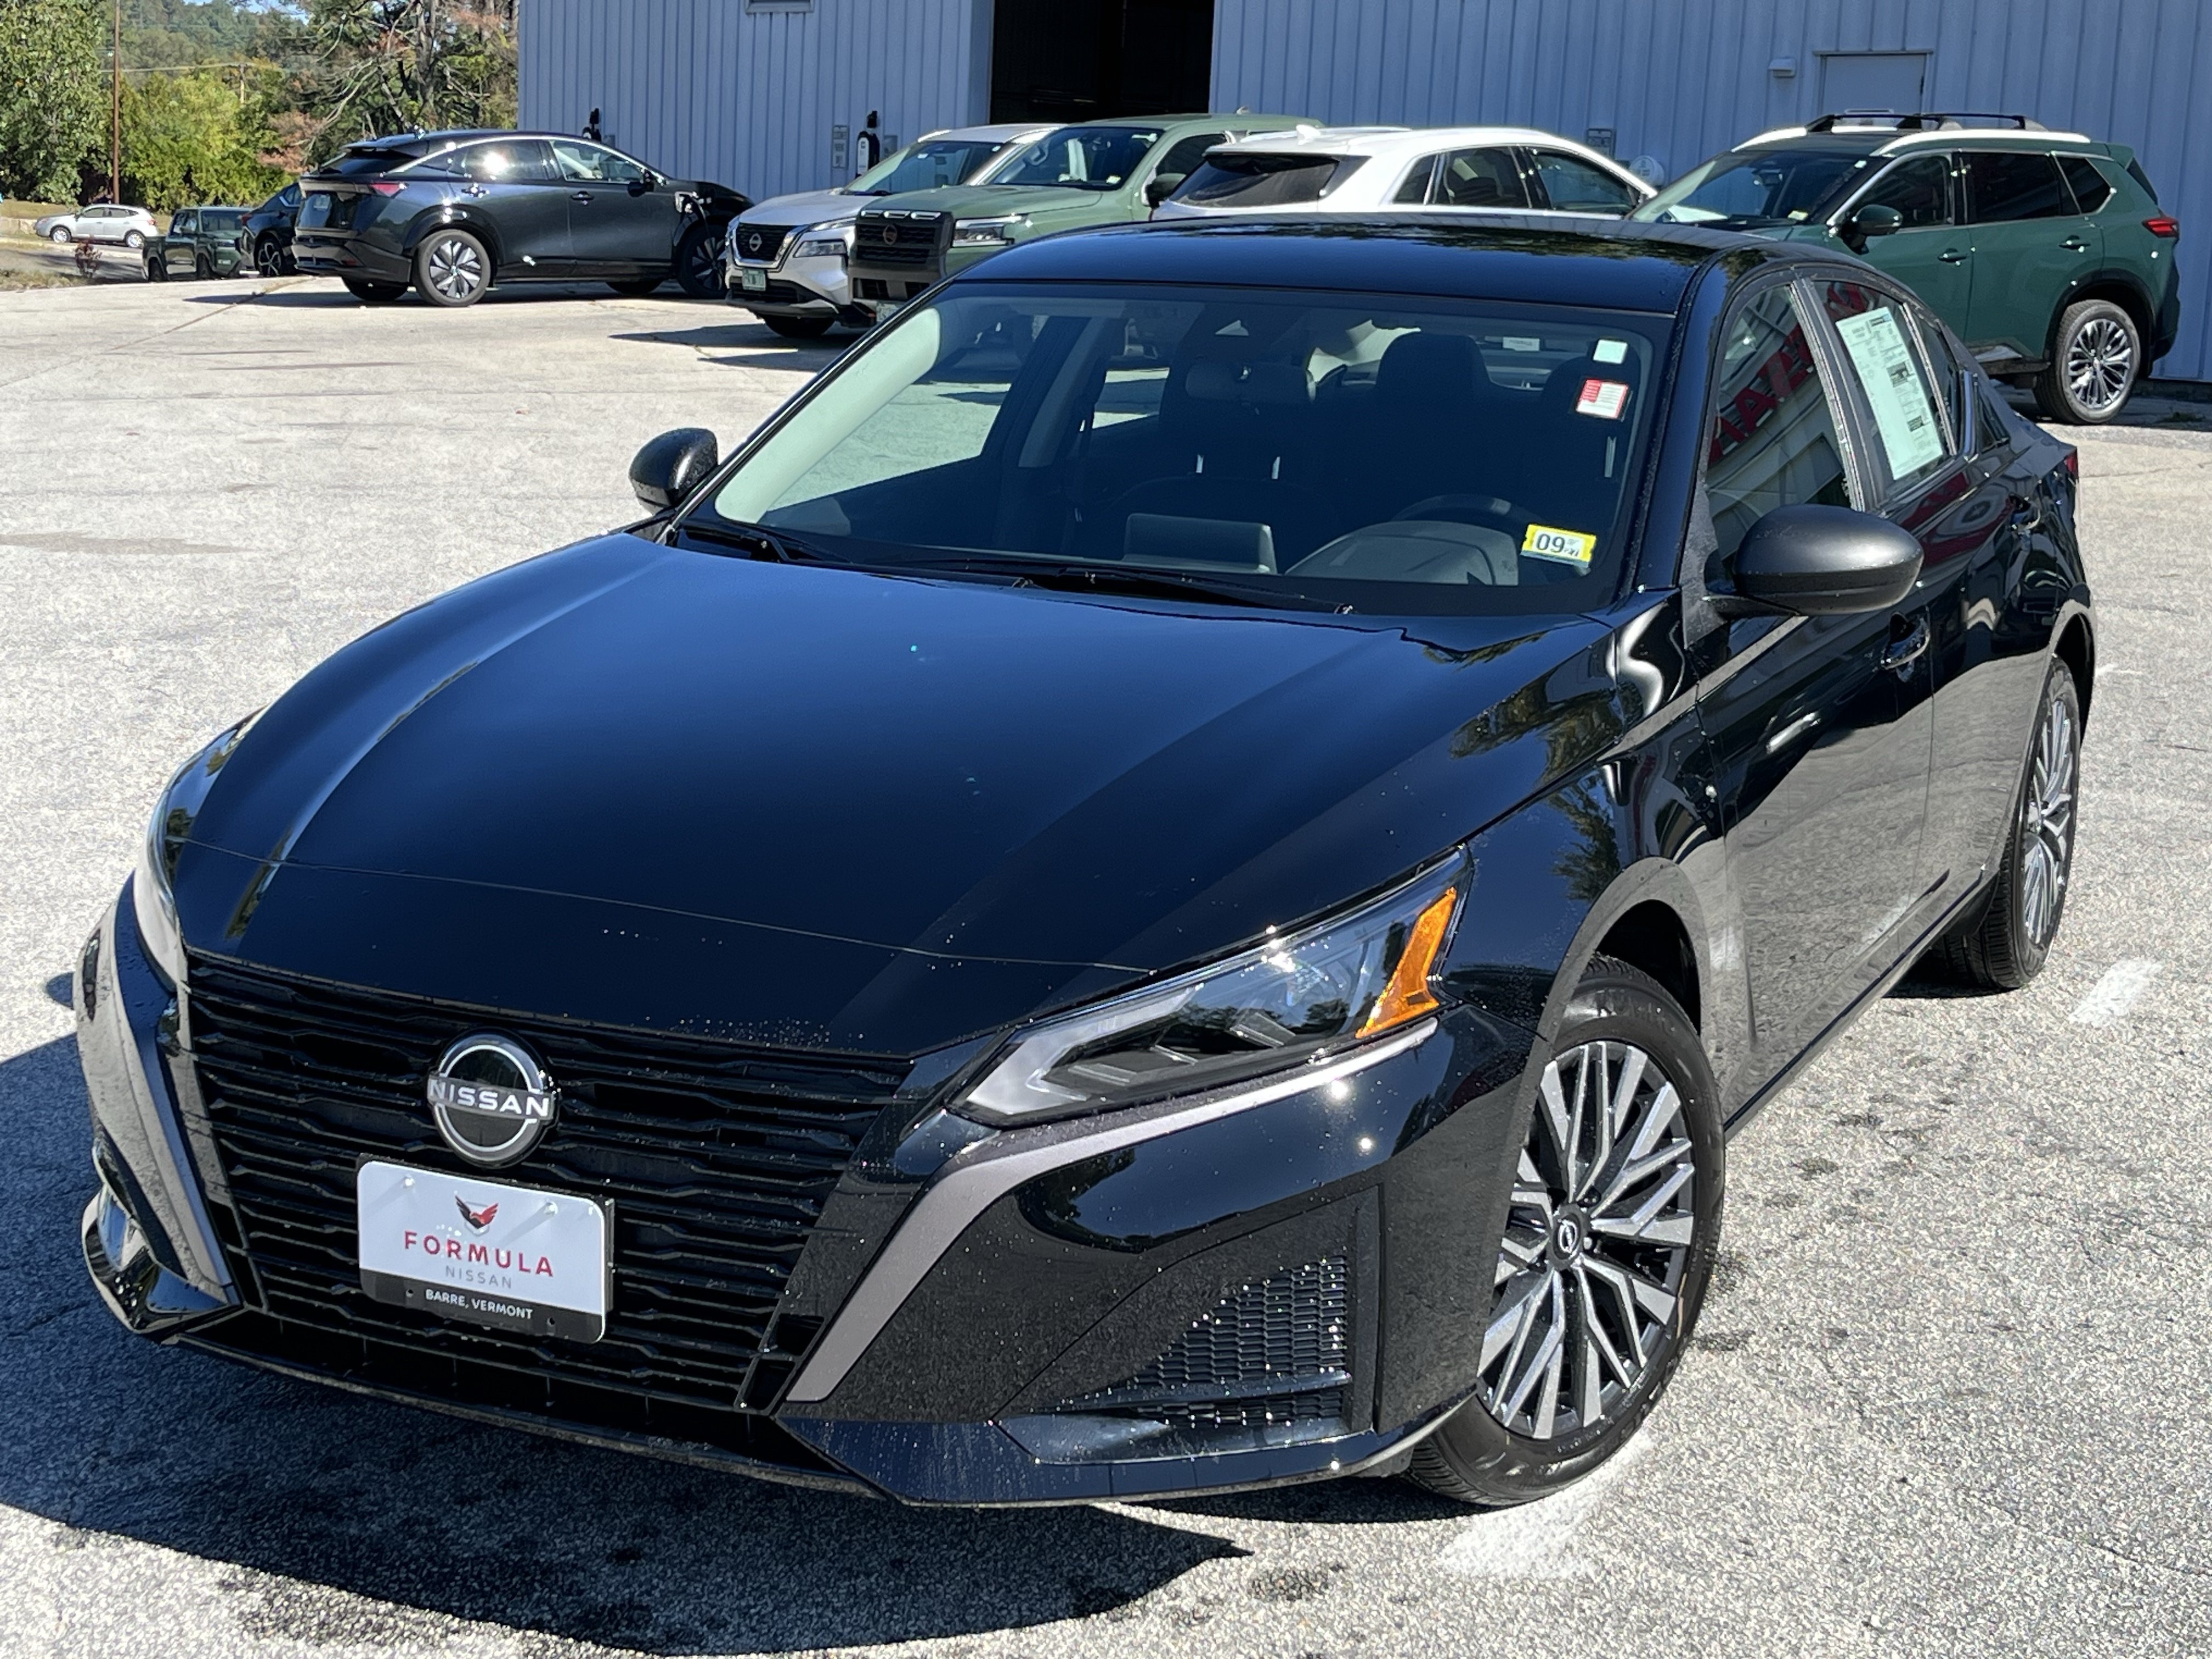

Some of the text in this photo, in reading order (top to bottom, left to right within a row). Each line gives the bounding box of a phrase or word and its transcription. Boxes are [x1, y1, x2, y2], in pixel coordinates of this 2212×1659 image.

[1537, 533, 1565, 554] 09
[429, 1079, 549, 1117] NISSAN
[404, 1231, 554, 1277] FORMULA
[445, 1265, 512, 1289] NISSAN
[425, 1289, 533, 1319] BARRE, VERMONT
